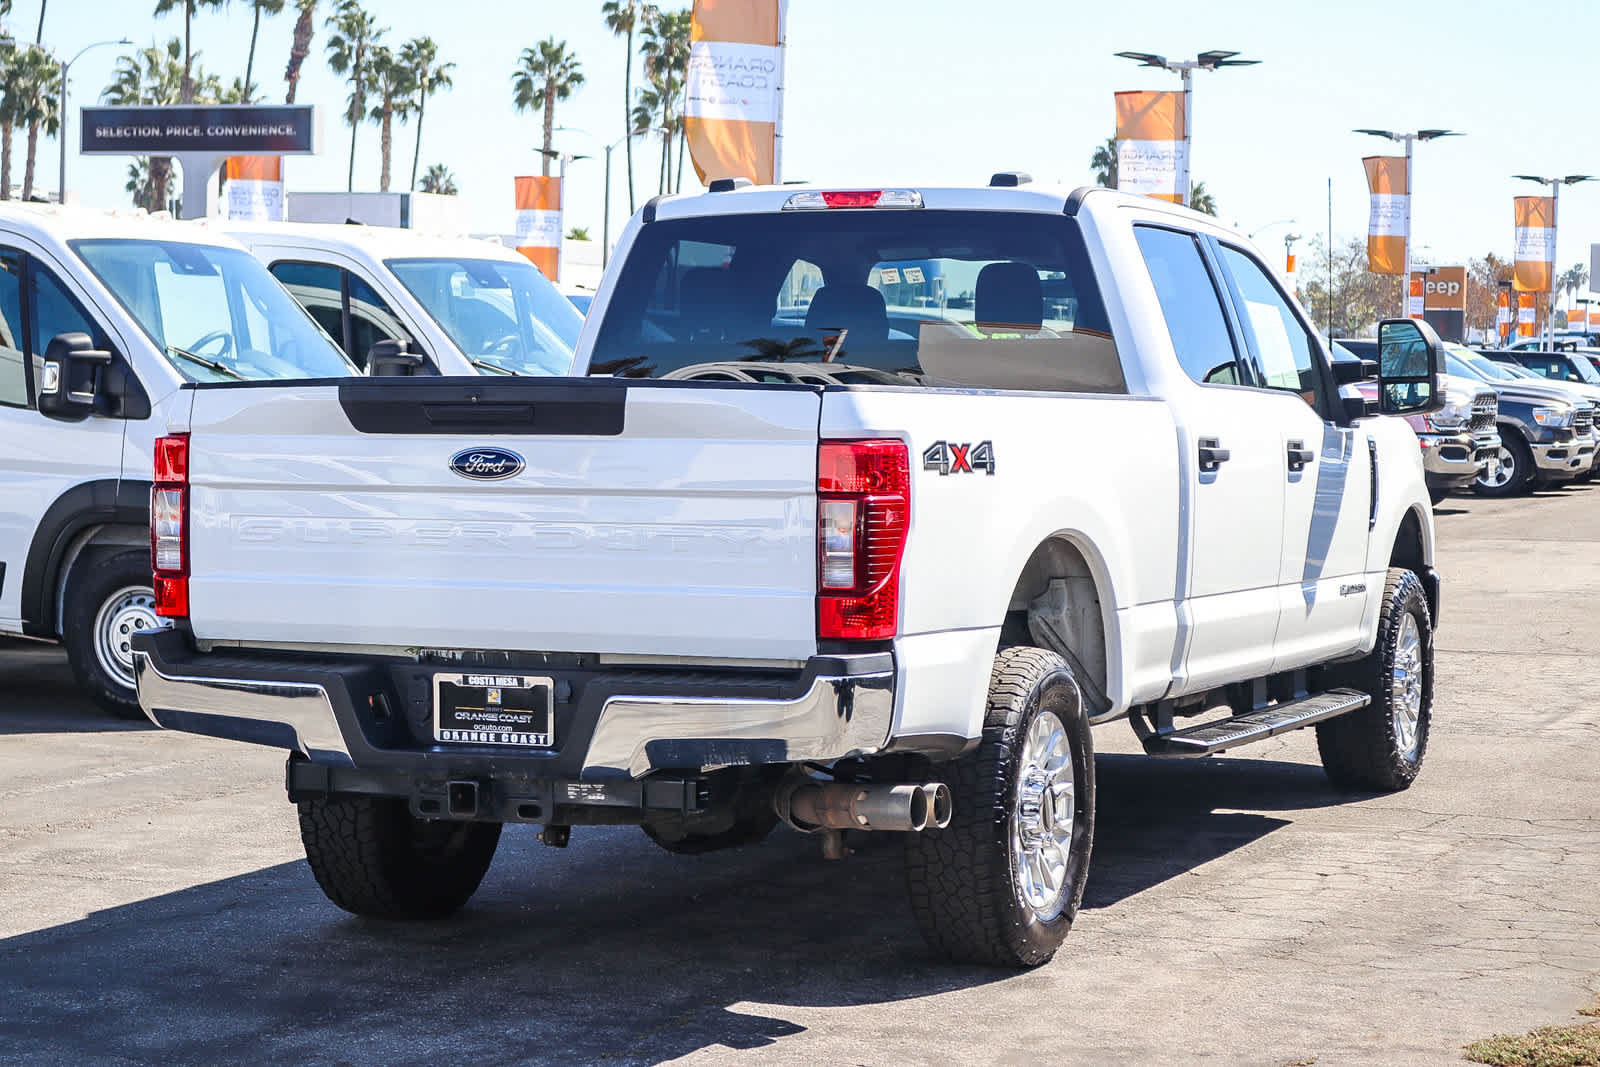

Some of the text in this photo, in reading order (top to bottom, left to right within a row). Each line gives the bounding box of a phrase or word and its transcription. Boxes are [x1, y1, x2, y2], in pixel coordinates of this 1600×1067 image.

[95, 124, 297, 138] SELECTION. PRICE. CONVENIENCE.
[1425, 281, 1460, 297] eep
[465, 454, 506, 473] Ford
[468, 676, 518, 687] COSTA MESA
[454, 711, 533, 724] ORANGE COAST
[473, 723, 513, 732] ocauto.com
[443, 731, 546, 745] ORANGE COAST
